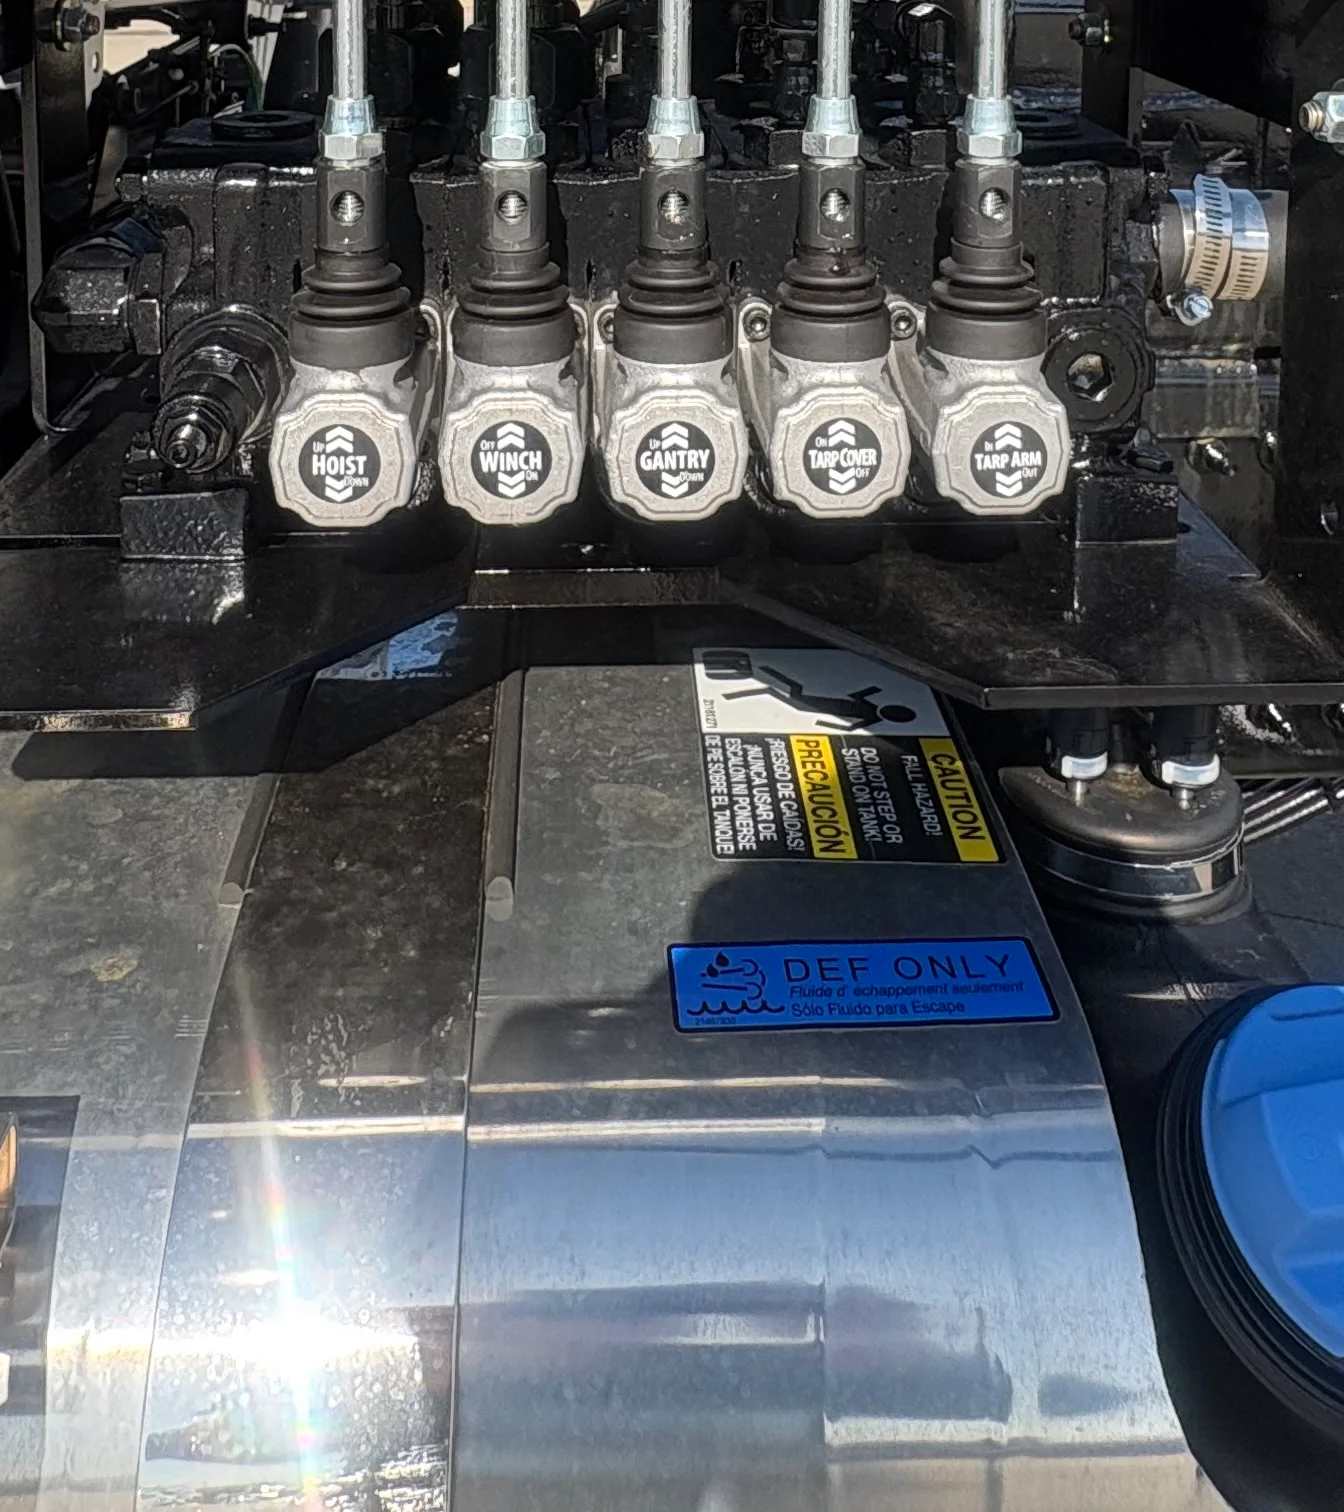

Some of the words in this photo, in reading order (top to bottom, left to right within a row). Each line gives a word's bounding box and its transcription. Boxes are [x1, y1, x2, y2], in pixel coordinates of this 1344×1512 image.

[312, 454, 367, 476] HOIST
[479, 450, 542, 473] WINCH
[640, 449, 710, 471] GANTRY
[974, 453, 1010, 471] TARP
[1010, 450, 1042, 468] ARM
[841, 748, 866, 783] STAND
[860, 747, 880, 763] DO
[709, 763, 727, 795] SOBRE
[866, 766, 887, 789] NOT
[901, 755, 923, 781] FALL
[776, 782, 796, 799] DE
[796, 739, 849, 854] PRECAUCIÓN
[852, 785, 870, 803] ON
[931, 753, 986, 840] CAUTION
[752, 788, 774, 821] USAR
[874, 791, 897, 822] STEP
[733, 797, 756, 851] PONERSE
[758, 823, 777, 841] DE
[883, 824, 903, 844] OR
[783, 956, 871, 983] DEF
[893, 954, 1010, 981] ONLY
[828, 1001, 872, 1017] Fluido
[912, 999, 965, 1016] Escape
